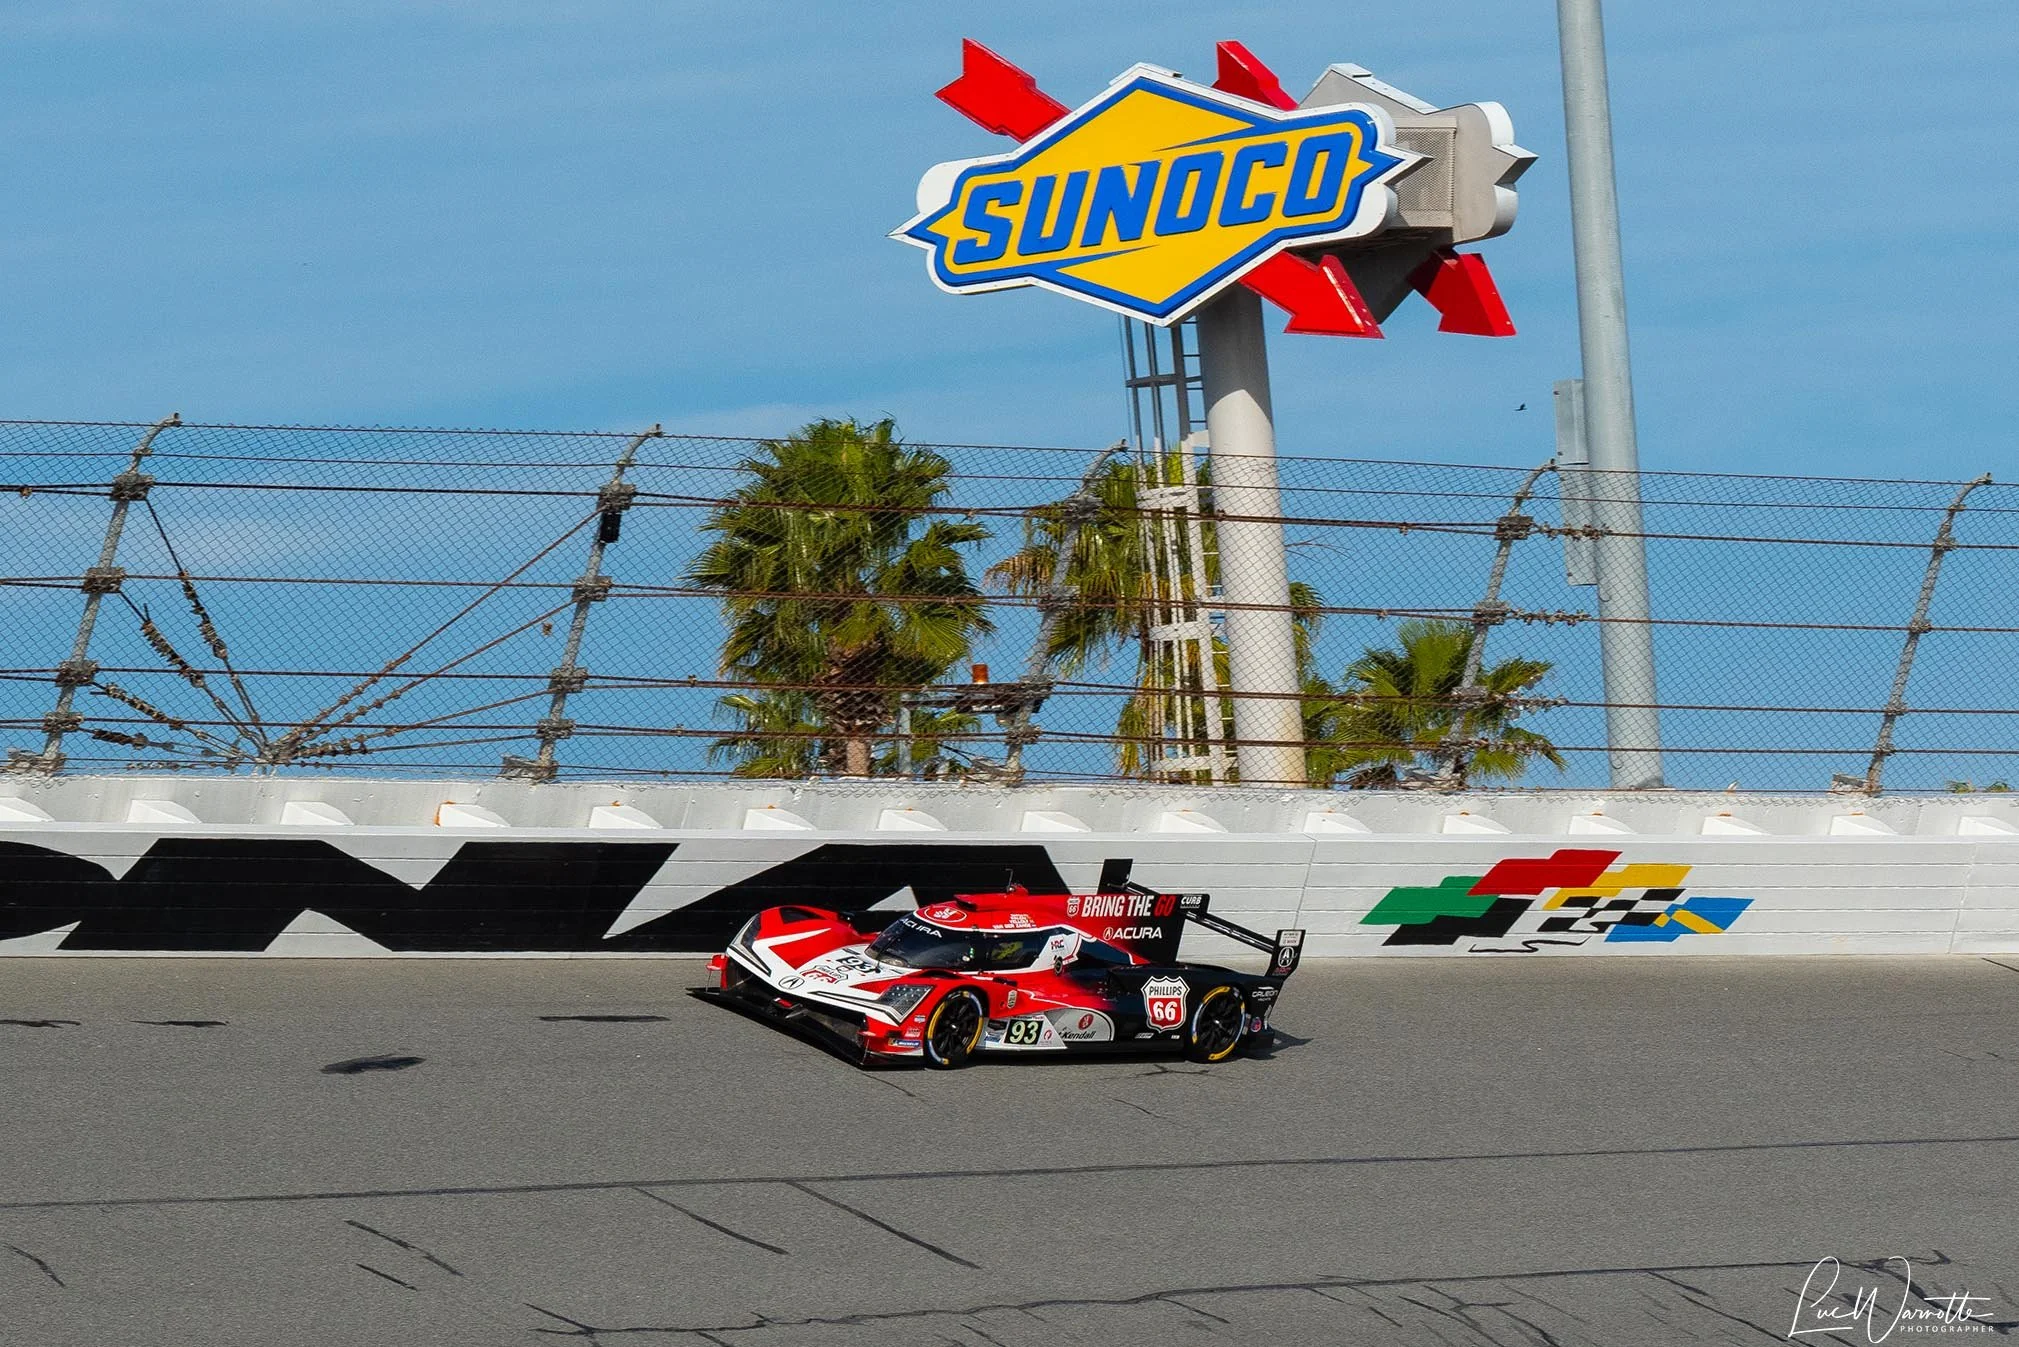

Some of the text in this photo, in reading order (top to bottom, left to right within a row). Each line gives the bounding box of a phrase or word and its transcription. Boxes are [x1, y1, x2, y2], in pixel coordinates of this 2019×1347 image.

[953, 131, 1354, 265] SUNOCO
[1081, 895, 1176, 918] BRING THE GO
[1181, 896, 1202, 905] CURB
[900, 917, 942, 939] ACURA
[1112, 926, 1163, 940] ACURA
[1149, 985, 1183, 996] PHILLIPS
[1153, 1001, 1179, 1021] 66
[1009, 1020, 1039, 1044] 93
[1061, 1030, 1096, 1040] Kendall
